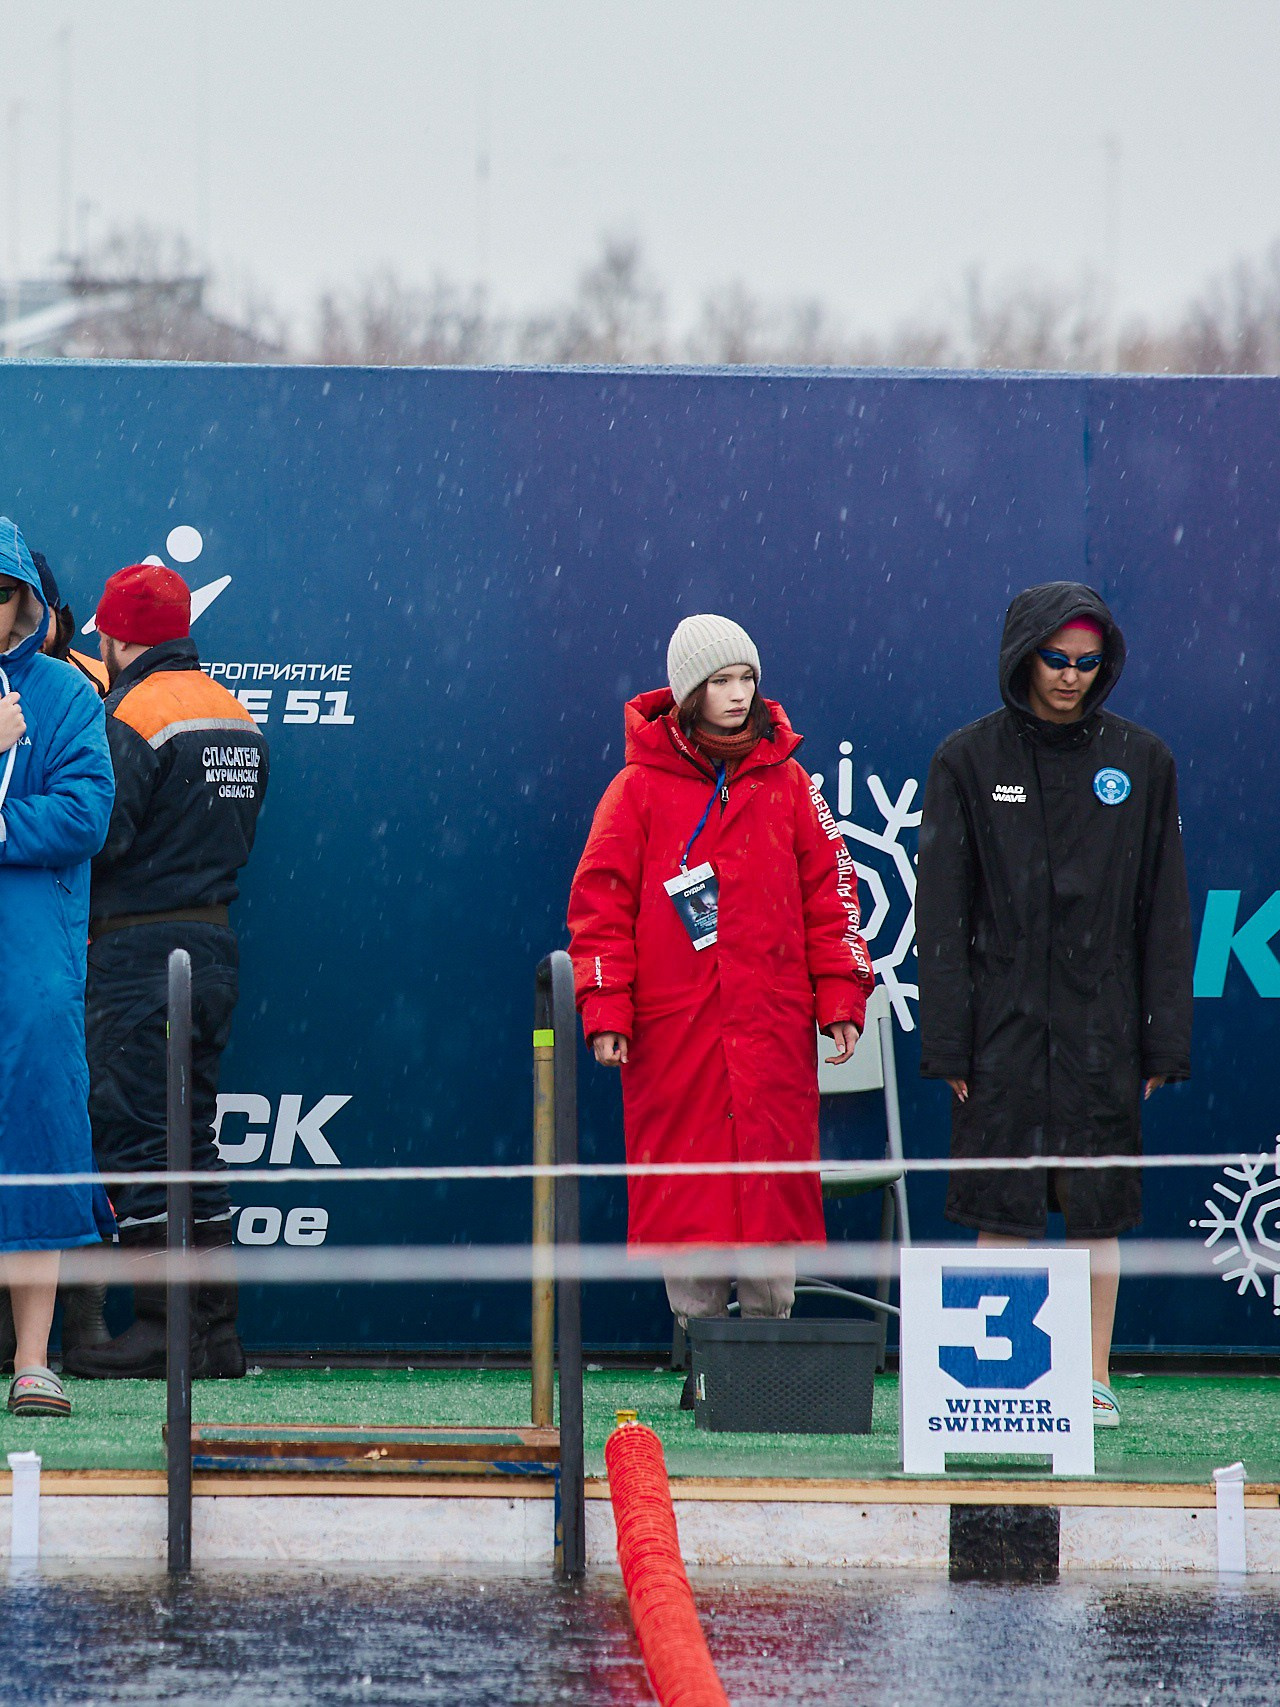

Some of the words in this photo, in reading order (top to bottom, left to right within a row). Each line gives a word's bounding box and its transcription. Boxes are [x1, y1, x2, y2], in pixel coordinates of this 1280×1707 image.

[283, 691, 355, 724] 51
[202, 746, 261, 767] СПАСАТЕЛЬ
[219, 785, 254, 798] ОБЛАСТЬ
[992, 793, 1027, 803] WAVE
[995, 784, 1024, 794] MAD
[808, 784, 841, 841] NOREBO
[835, 843, 853, 898] FUTURE.
[683, 882, 706, 898] СУДЬЯ
[229, 1206, 329, 1246] ое
[939, 1266, 1052, 1390] 3
[946, 1399, 1052, 1414] WINTER
[928, 1417, 1071, 1433] SWIMMING
